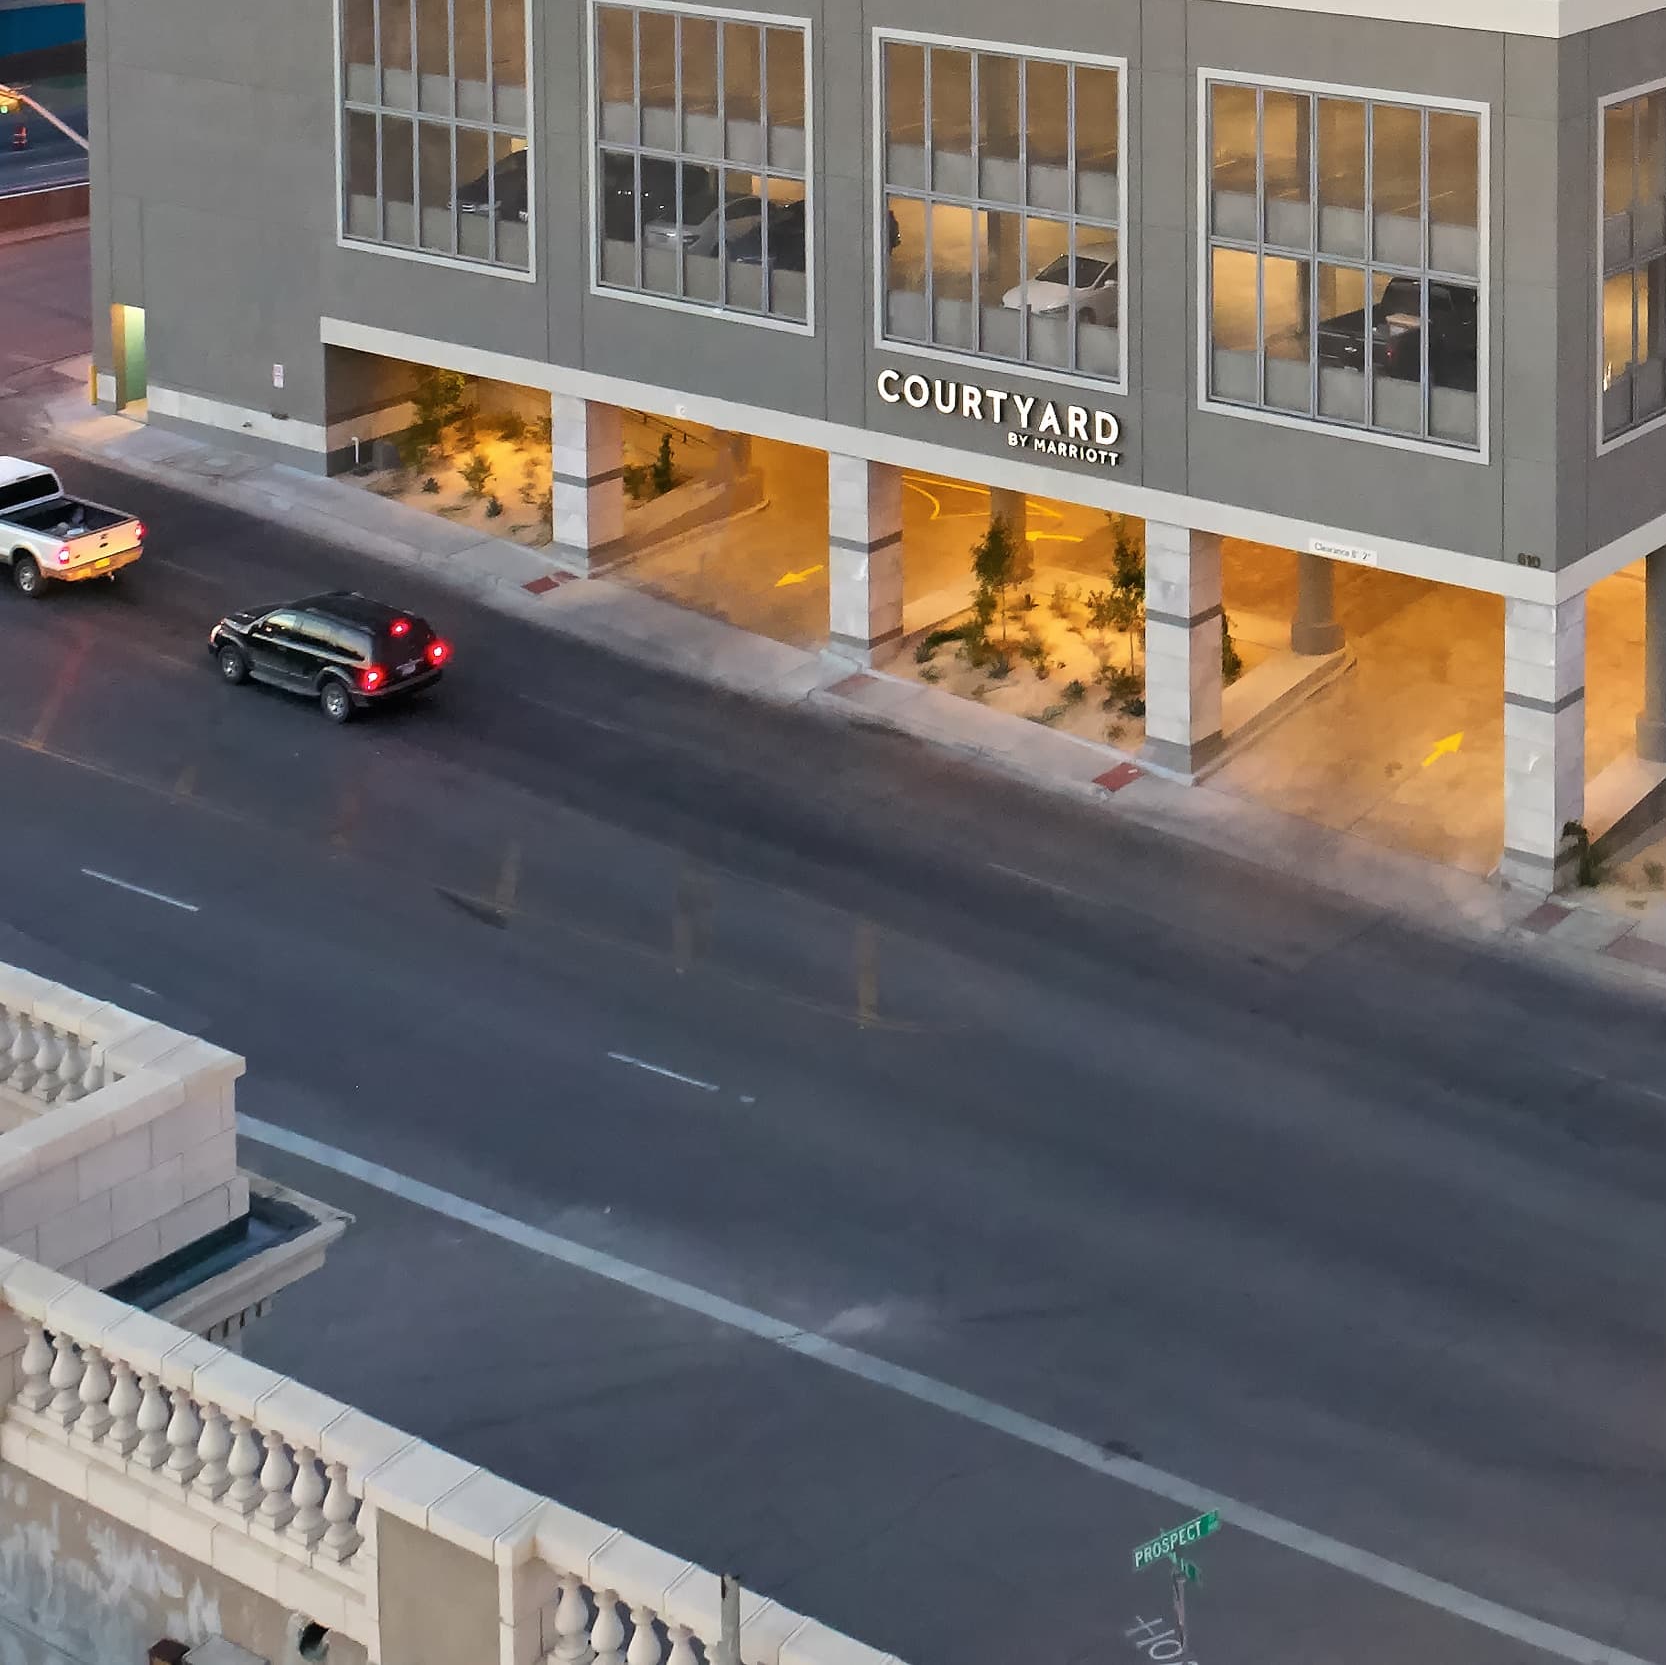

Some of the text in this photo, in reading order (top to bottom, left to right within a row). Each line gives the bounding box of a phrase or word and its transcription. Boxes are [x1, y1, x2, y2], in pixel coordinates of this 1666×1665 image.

[877, 368, 1119, 445] COURTYARD
[1007, 431, 1119, 466] BY MARRIOTT
[1314, 541, 1350, 557] Clearance
[1134, 1520, 1201, 1568] PROSPECT
